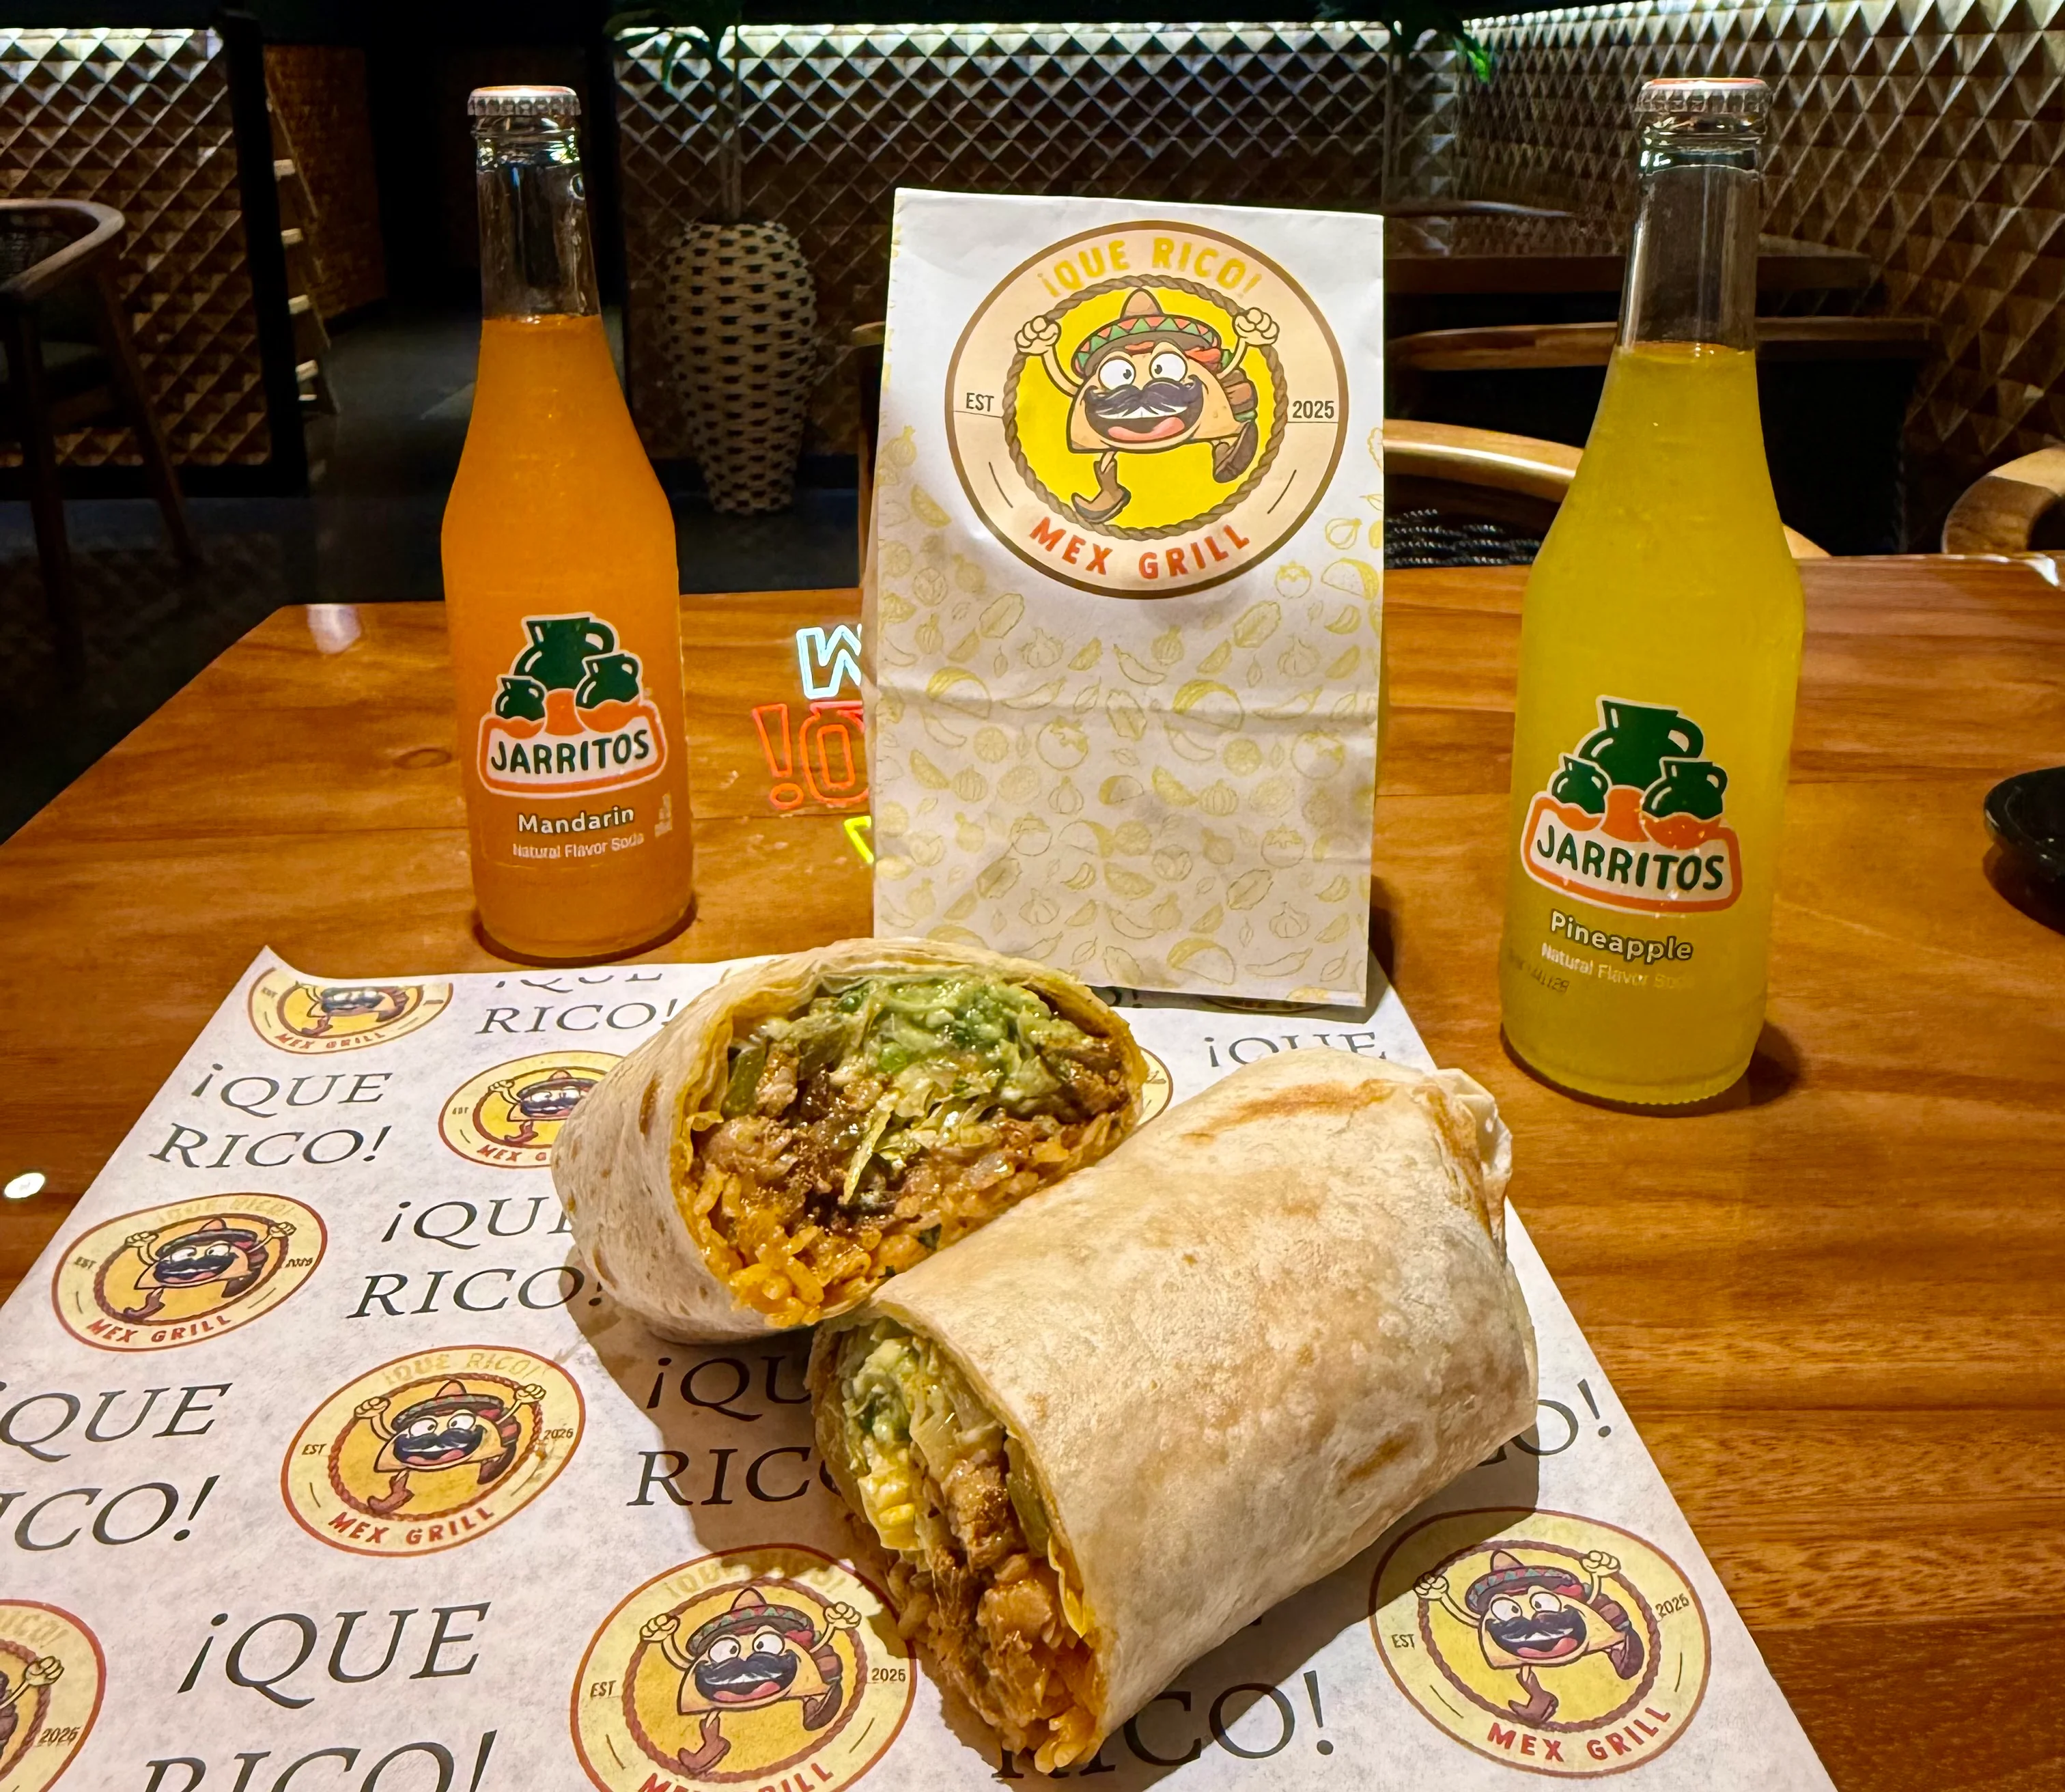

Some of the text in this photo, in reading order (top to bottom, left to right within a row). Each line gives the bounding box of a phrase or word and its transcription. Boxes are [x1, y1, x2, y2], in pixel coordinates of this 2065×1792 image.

[1037, 236, 1262, 298] ¡QUE RICO!
[966, 392, 994, 412] EST
[1292, 400, 1335, 419] 2025
[1029, 516, 1250, 580] MEX GRILL
[490, 728, 651, 775] JARRITOS
[518, 806, 635, 835] Mandarin
[512, 832, 645, 859] Natural Flavor Soda
[1536, 824, 1725, 893] JARRITOS
[1549, 909, 1694, 964] Pineapple
[1541, 942, 1594, 976] Natural
[1597, 963, 1648, 988] Flavor
[475, 998, 677, 1034] RICO!
[191, 1063, 393, 1118] ¡QUE
[148, 1123, 392, 1170] RICO!
[476, 1144, 522, 1162] MEX
[381, 1196, 572, 1250] ¡QU
[85, 1314, 232, 1344] MEX GRILL
[645, 1355, 812, 1421] ¡QU
[301, 1443, 327, 1456] EST
[626, 1445, 839, 1506] RIC
[0, 1474, 221, 1552] CO!
[328, 1507, 495, 1544] MEX GRILL
[177, 1601, 492, 1709] ¡QUE
[1391, 1634, 1416, 1649] EST
[591, 1680, 617, 1697] EST
[992, 1670, 1334, 1780] CO!
[1487, 1706, 1671, 1764] MEX GRILL
